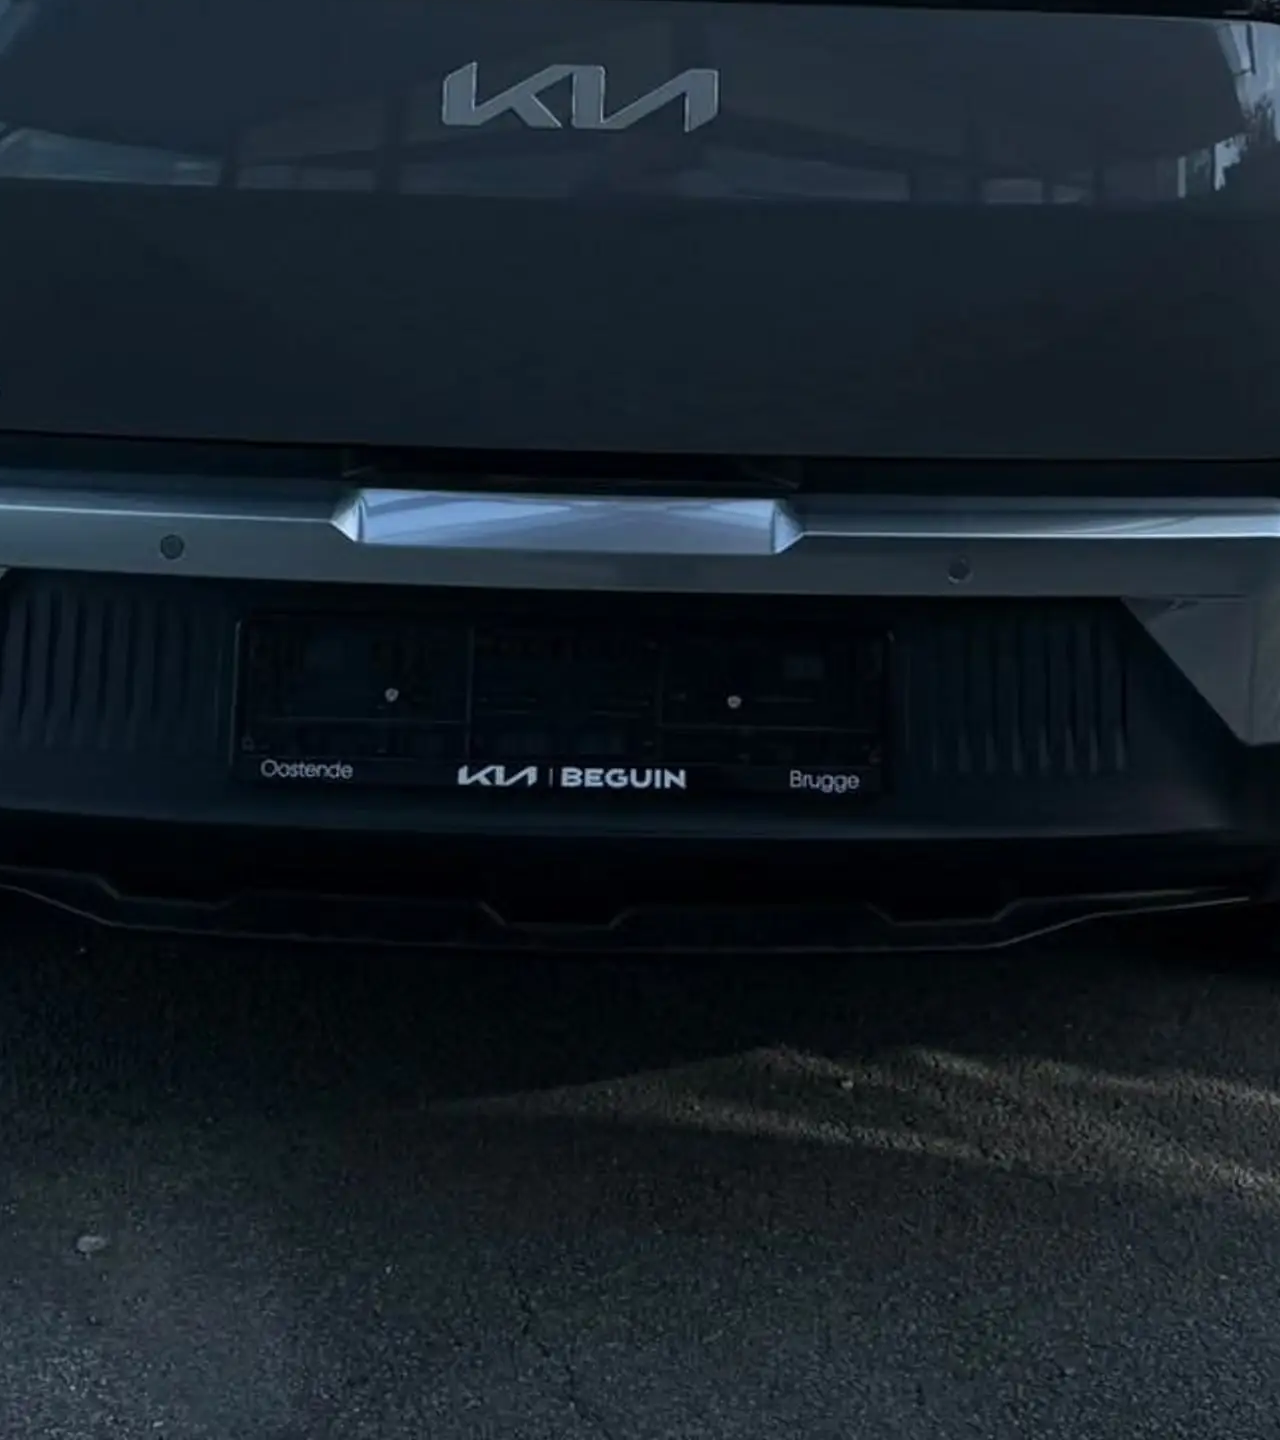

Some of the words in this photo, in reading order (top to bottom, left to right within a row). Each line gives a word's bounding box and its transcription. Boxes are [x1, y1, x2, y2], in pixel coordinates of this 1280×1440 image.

[442, 61, 721, 133] KIA
[260, 758, 354, 780] Oostende
[457, 765, 538, 787] KIA
[560, 767, 687, 790] BEGUIN
[789, 770, 859, 793] Brugge
